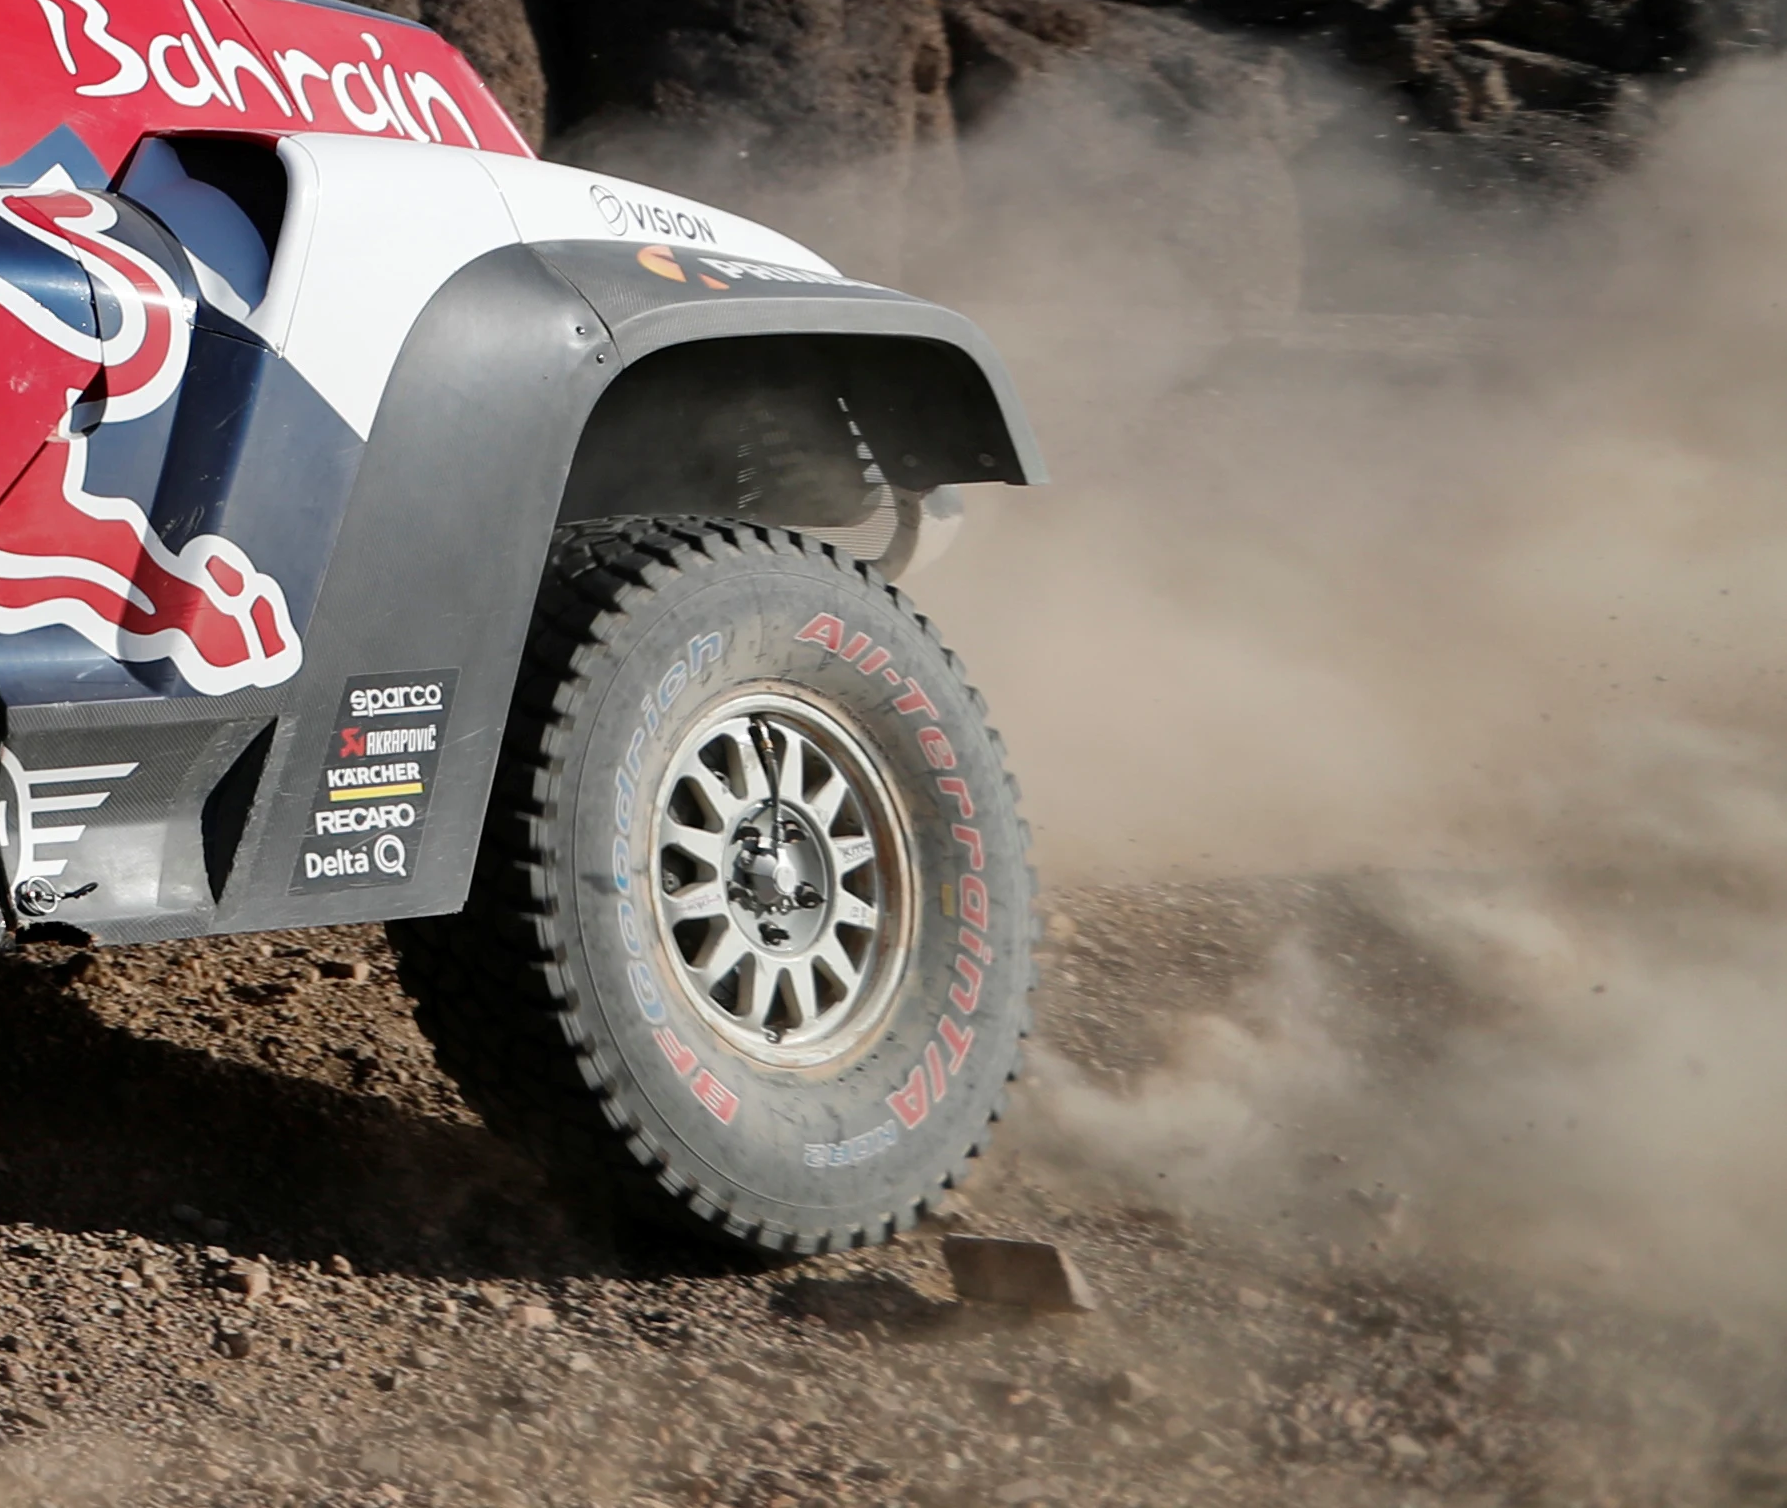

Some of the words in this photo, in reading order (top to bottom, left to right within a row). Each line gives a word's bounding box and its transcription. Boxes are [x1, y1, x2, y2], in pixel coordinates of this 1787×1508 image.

[626, 200, 718, 243] VISION
[349, 683, 443, 717] sparco
[366, 724, 437, 757] AKRAPOVIČ
[327, 762, 422, 788] KÄRCHER
[315, 803, 416, 835] RECARO
[304, 847, 370, 878] Delta
[612, 629, 740, 1126] BFGoodrich
